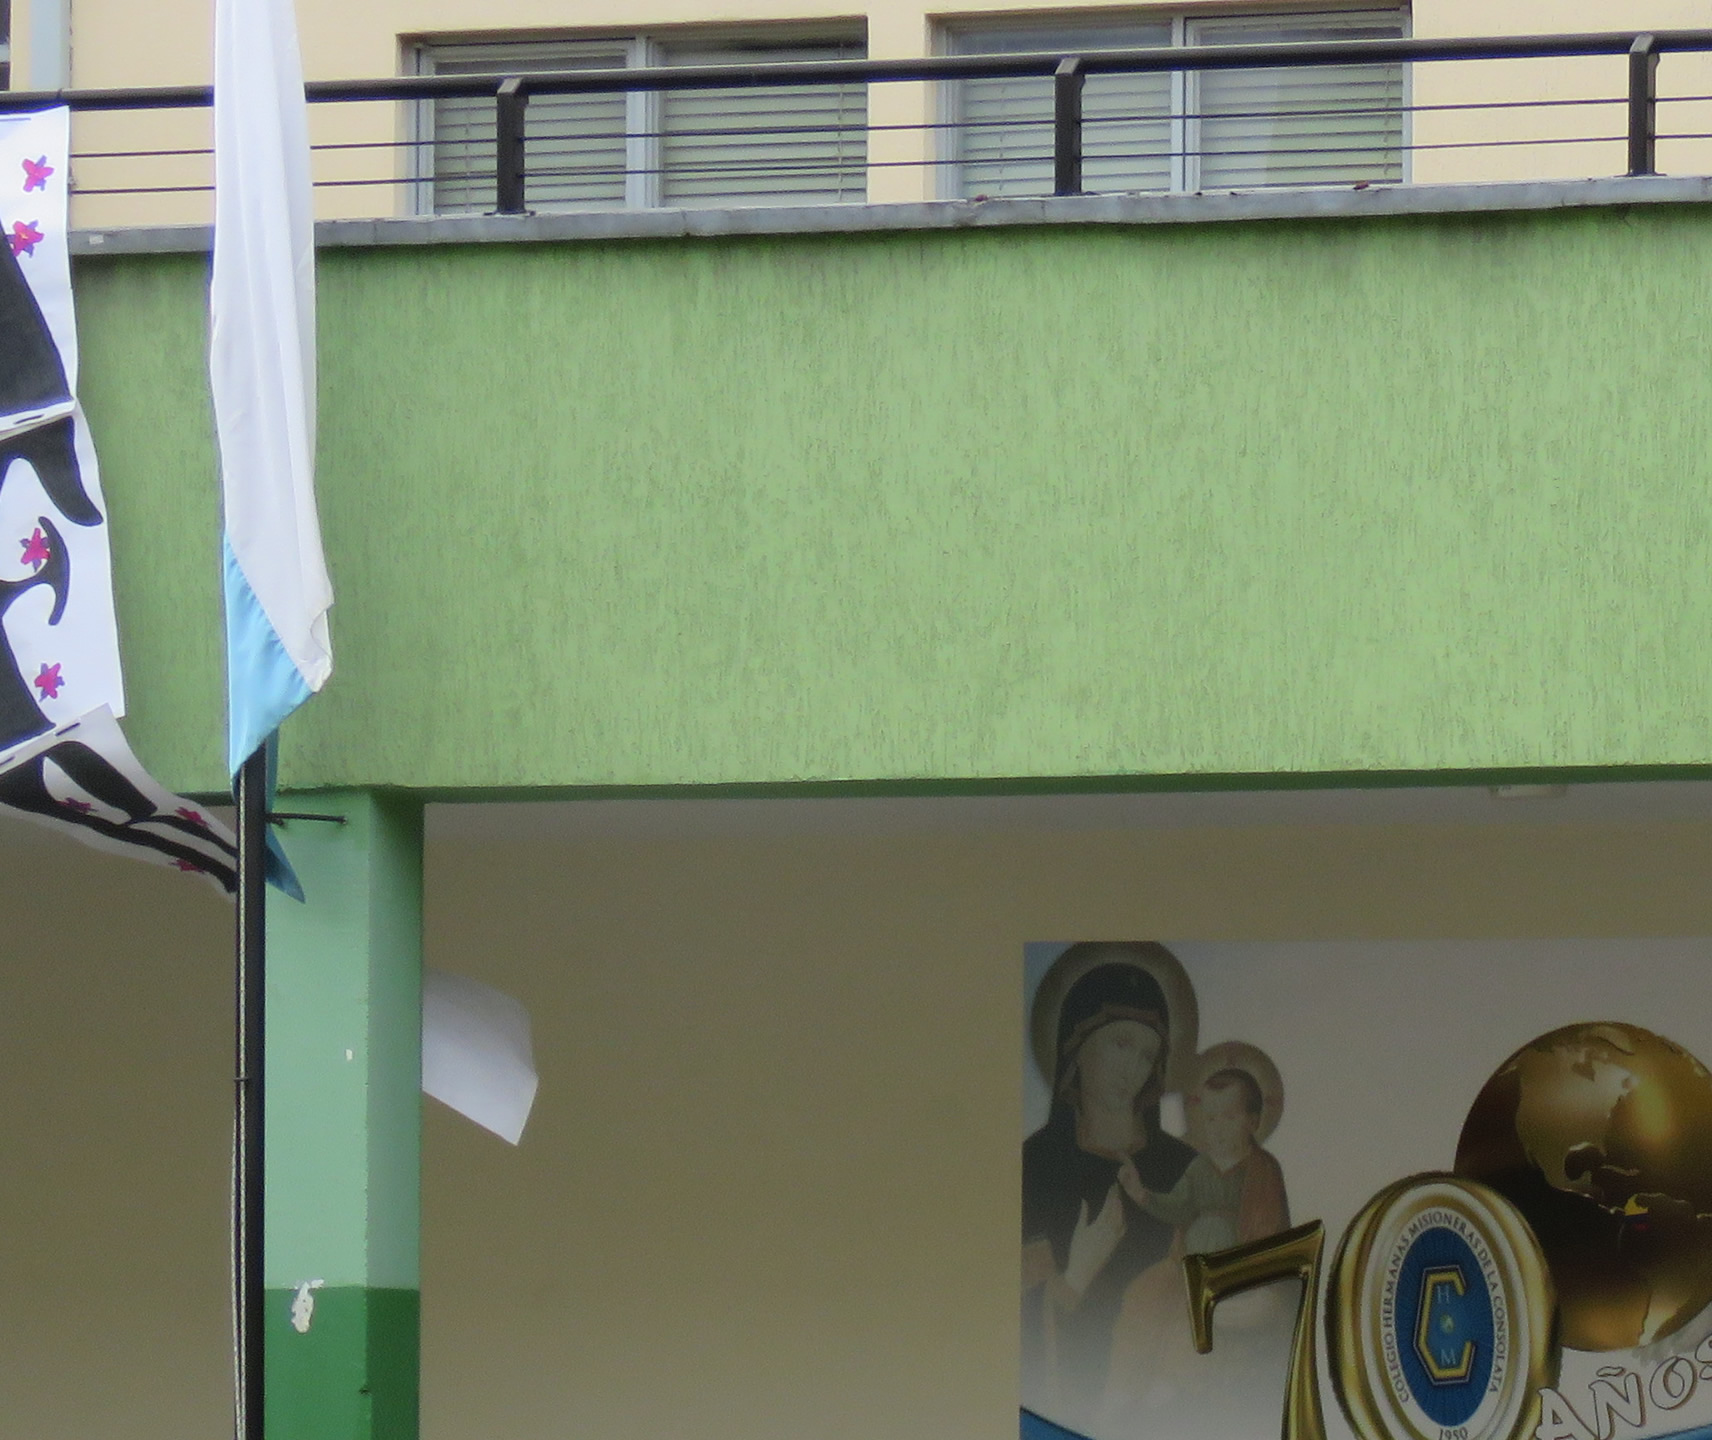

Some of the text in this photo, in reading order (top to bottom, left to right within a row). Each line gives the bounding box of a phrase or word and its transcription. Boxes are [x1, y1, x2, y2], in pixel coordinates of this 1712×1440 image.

[1382, 1210, 1507, 1403] COLEGIO HERMANAS MISIONERAS DE LA CONSOLATA
